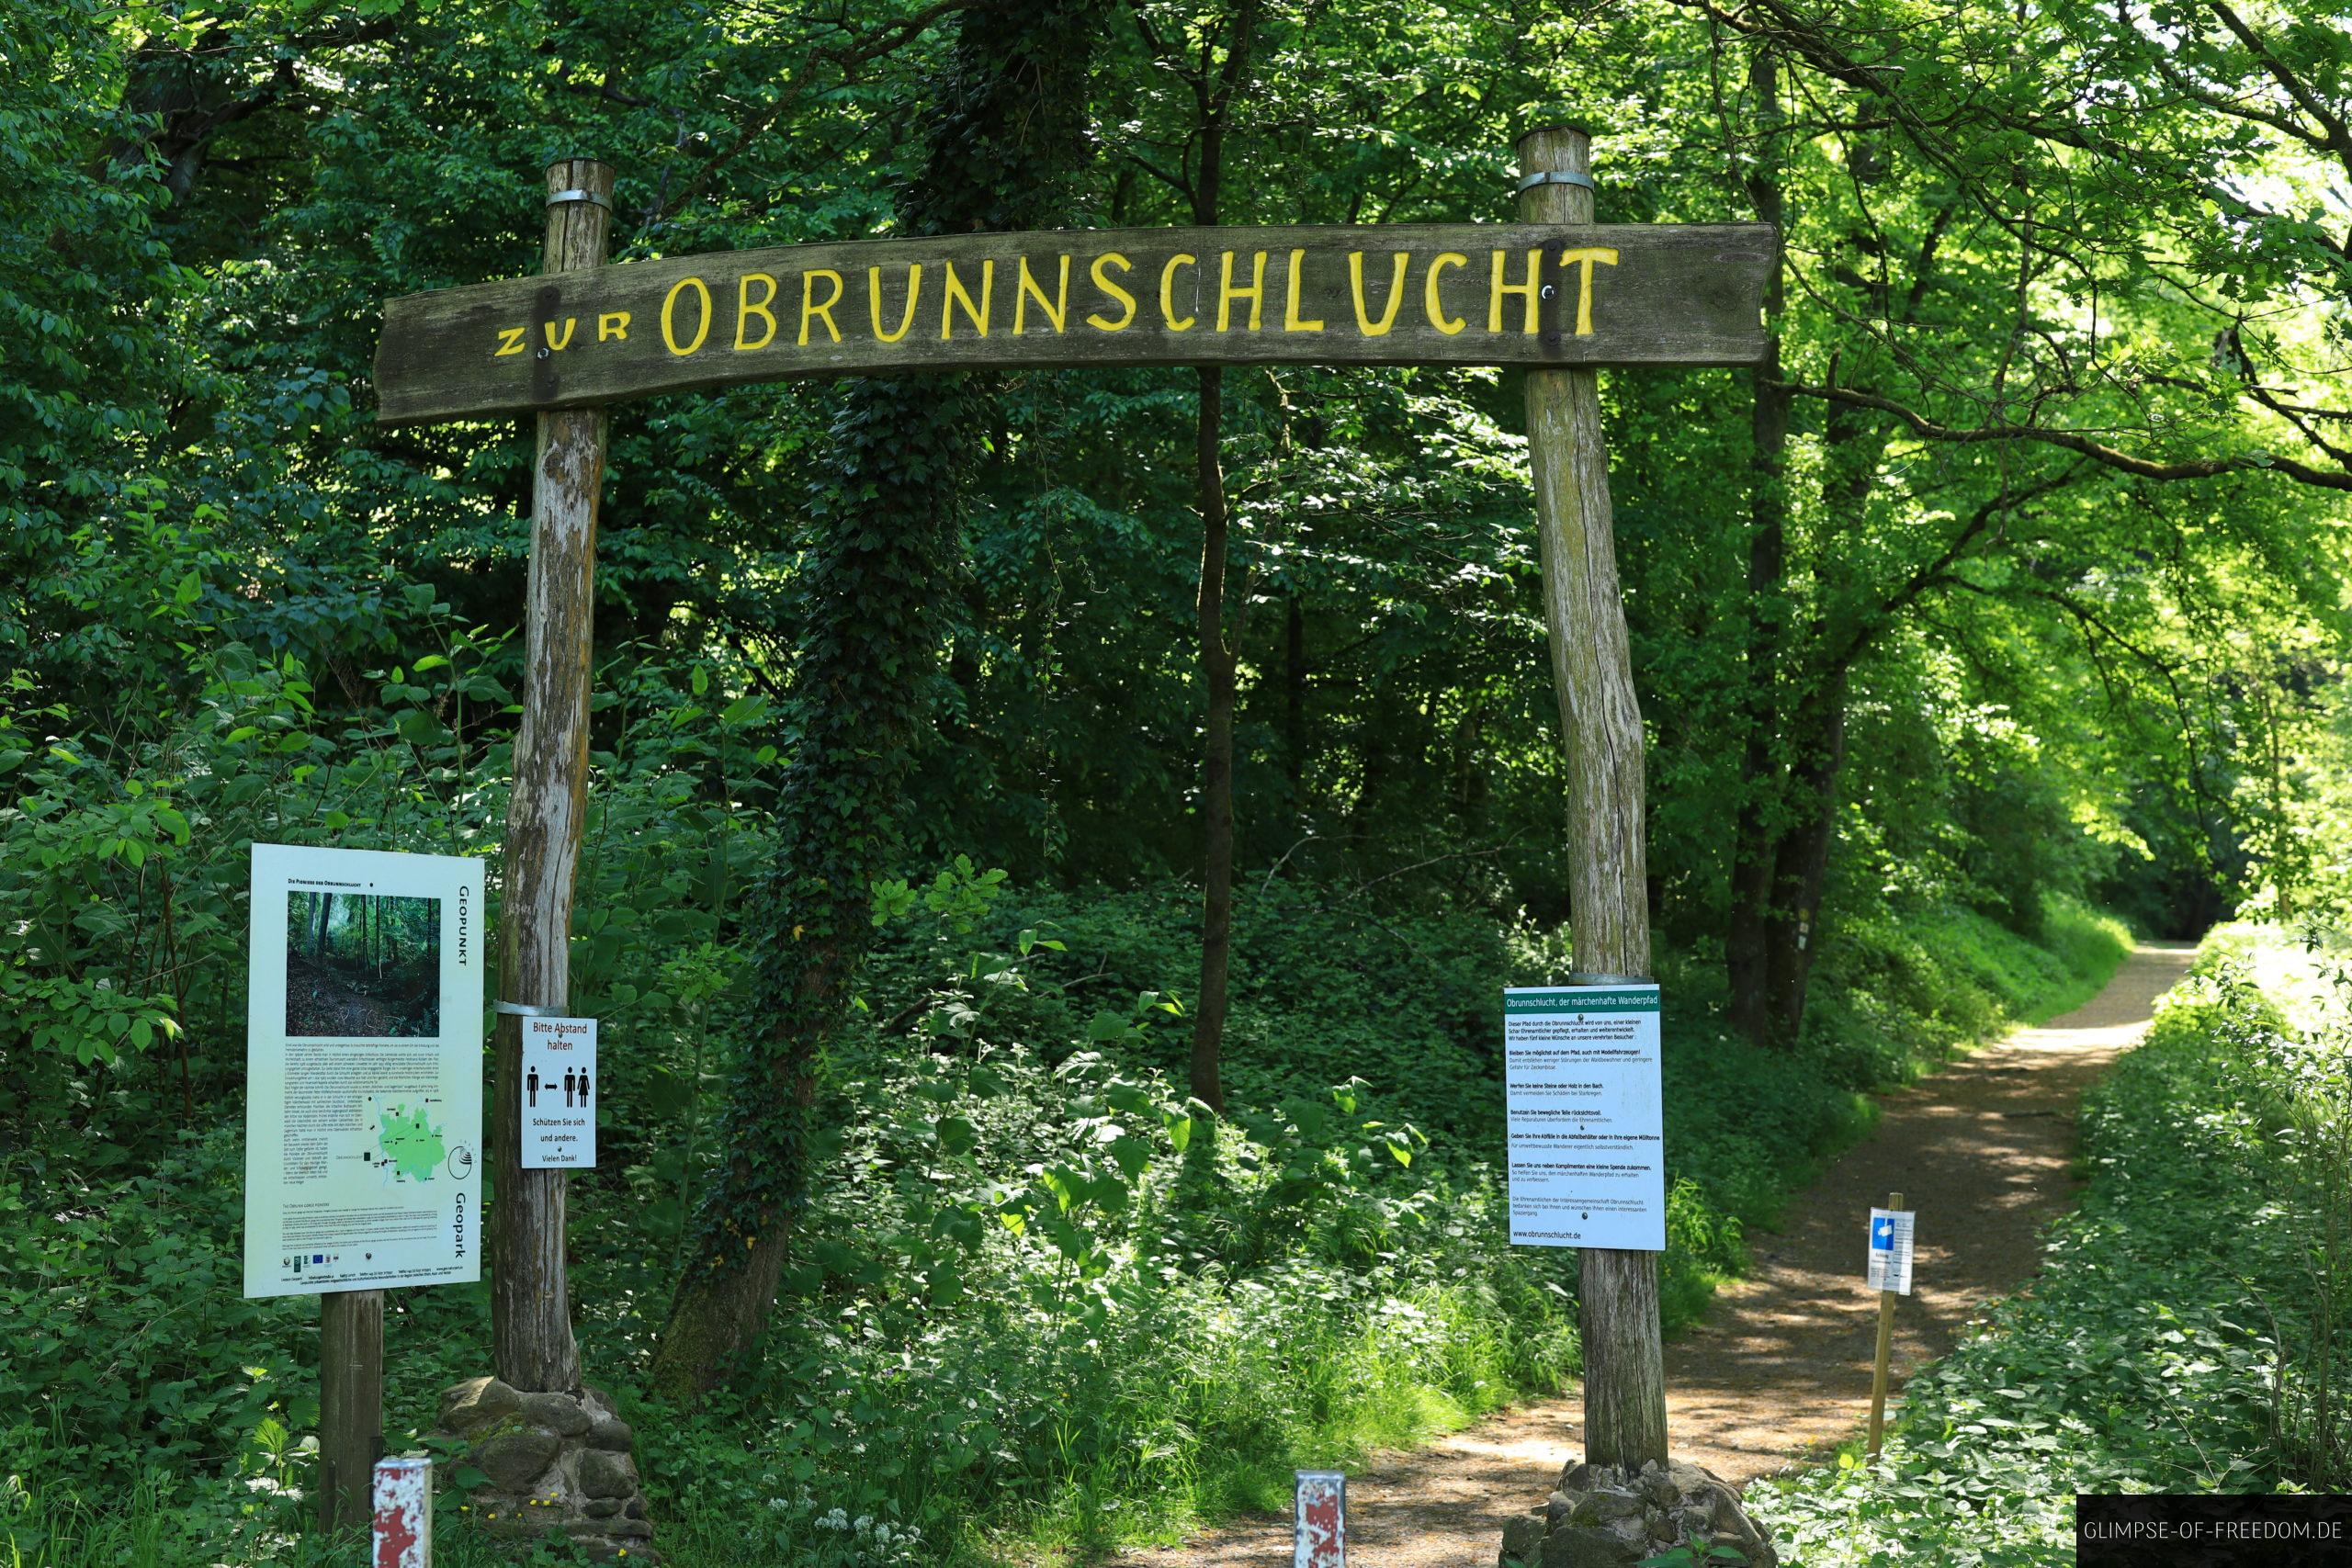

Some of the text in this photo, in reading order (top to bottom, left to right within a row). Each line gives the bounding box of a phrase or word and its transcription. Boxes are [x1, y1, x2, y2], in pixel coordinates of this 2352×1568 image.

[494, 247, 1618, 356] ZUR OBRUNNSCHLUCHT
[458, 886, 469, 966] GEOPUNKT
[1507, 995, 1658, 1008] Obrunnschlucht, der märchenhafte Wanderpfad
[534, 1022, 588, 1033] Bitte Abstand
[548, 1040, 573, 1051] halten
[533, 1118, 585, 1126] Schützen Sie sich
[453, 1192, 466, 1258] Geopark
[1513, 1231, 1581, 1239] www.obrunnschlucht.de
